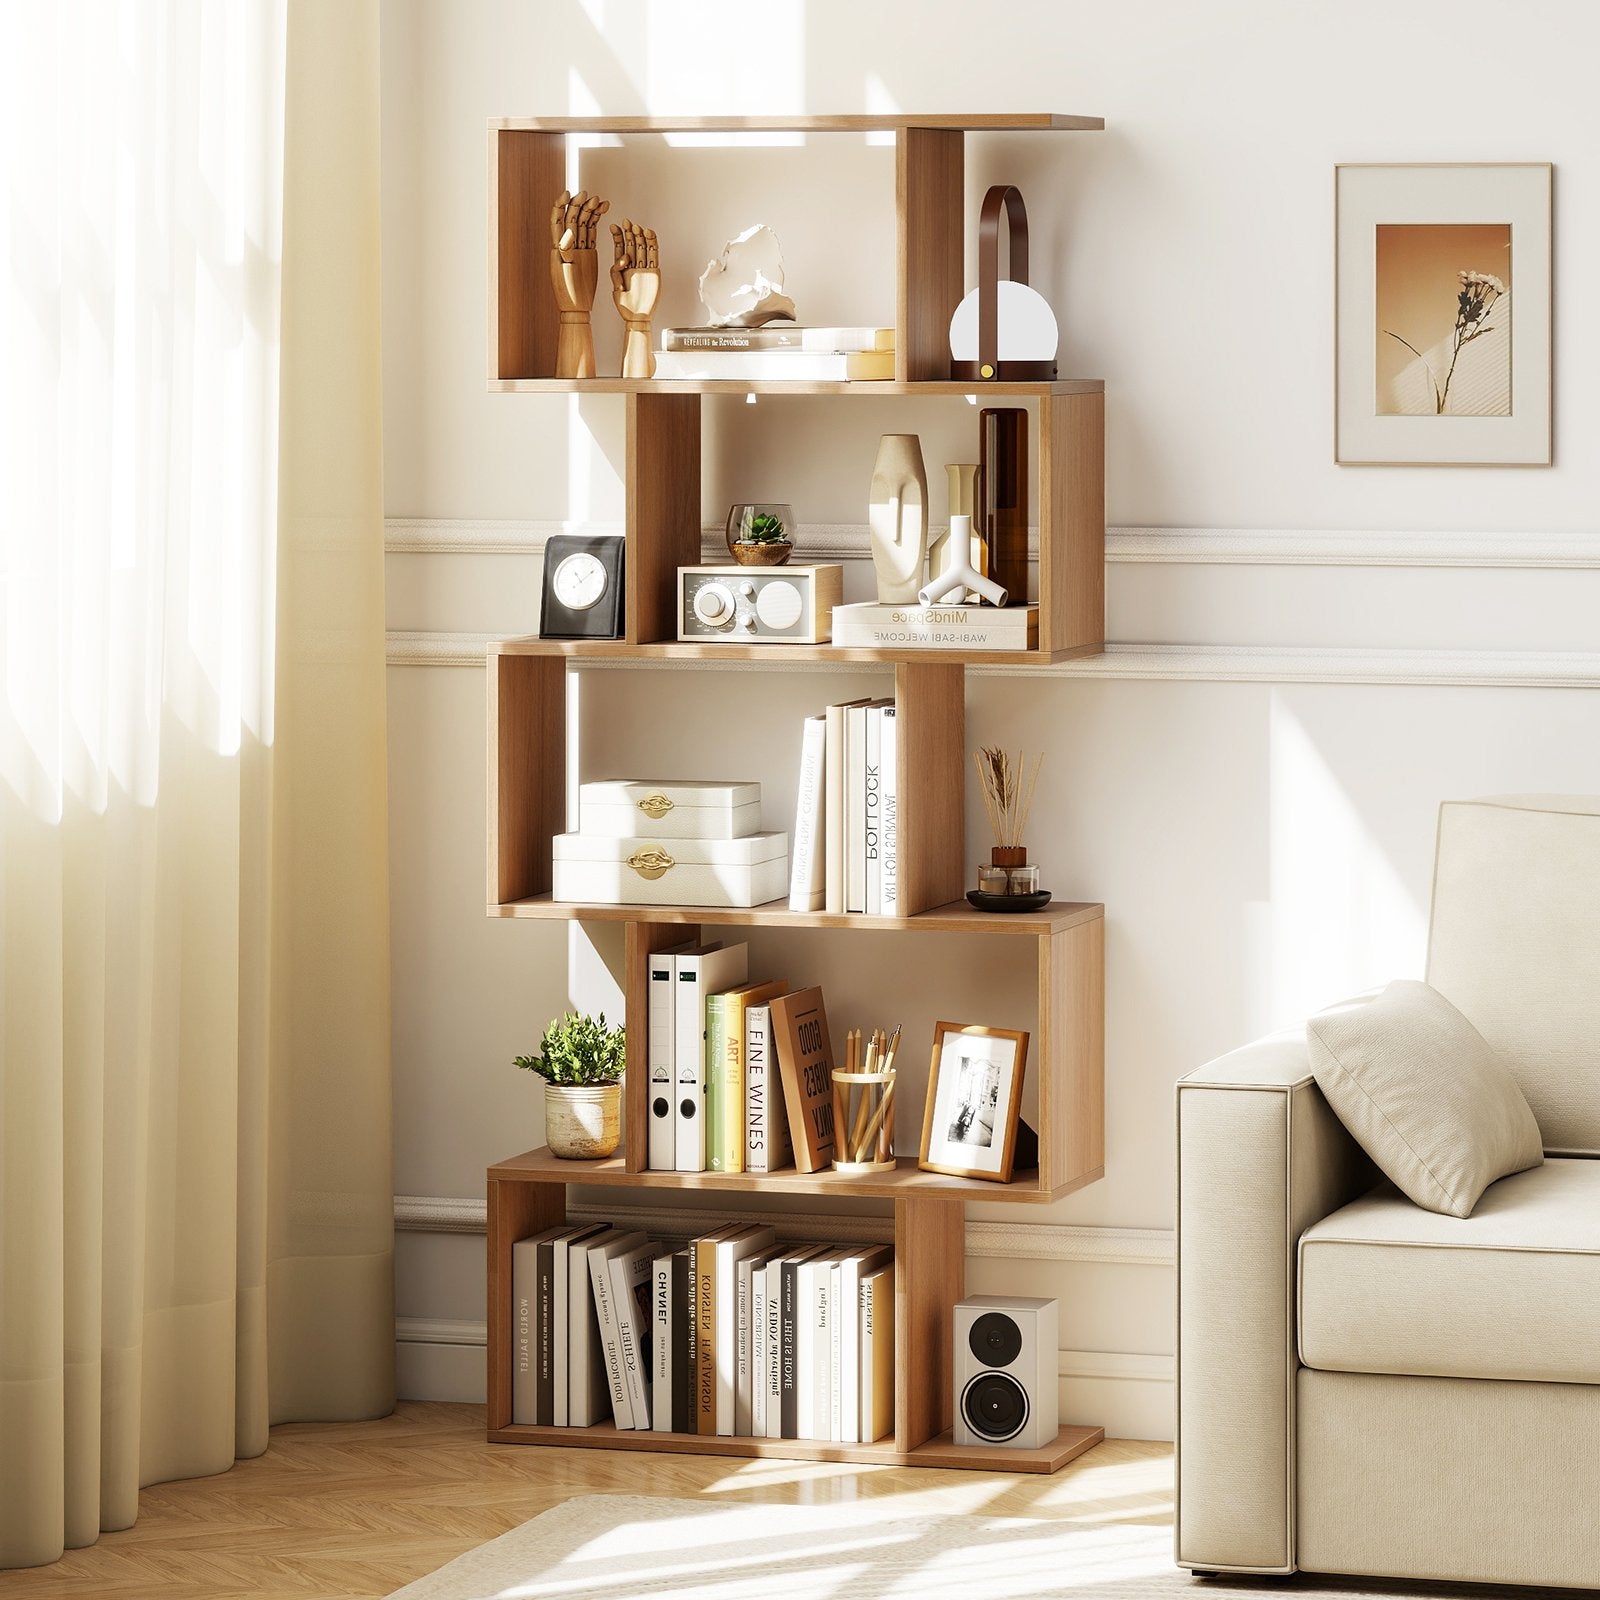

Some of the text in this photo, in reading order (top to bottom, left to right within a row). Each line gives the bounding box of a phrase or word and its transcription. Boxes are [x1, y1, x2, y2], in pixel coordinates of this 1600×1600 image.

[719, 336, 750, 347] Revolution
[727, 1036, 739, 1065] ART
[749, 1030, 764, 1075] FINE
[749, 1084, 764, 1151] WINES
